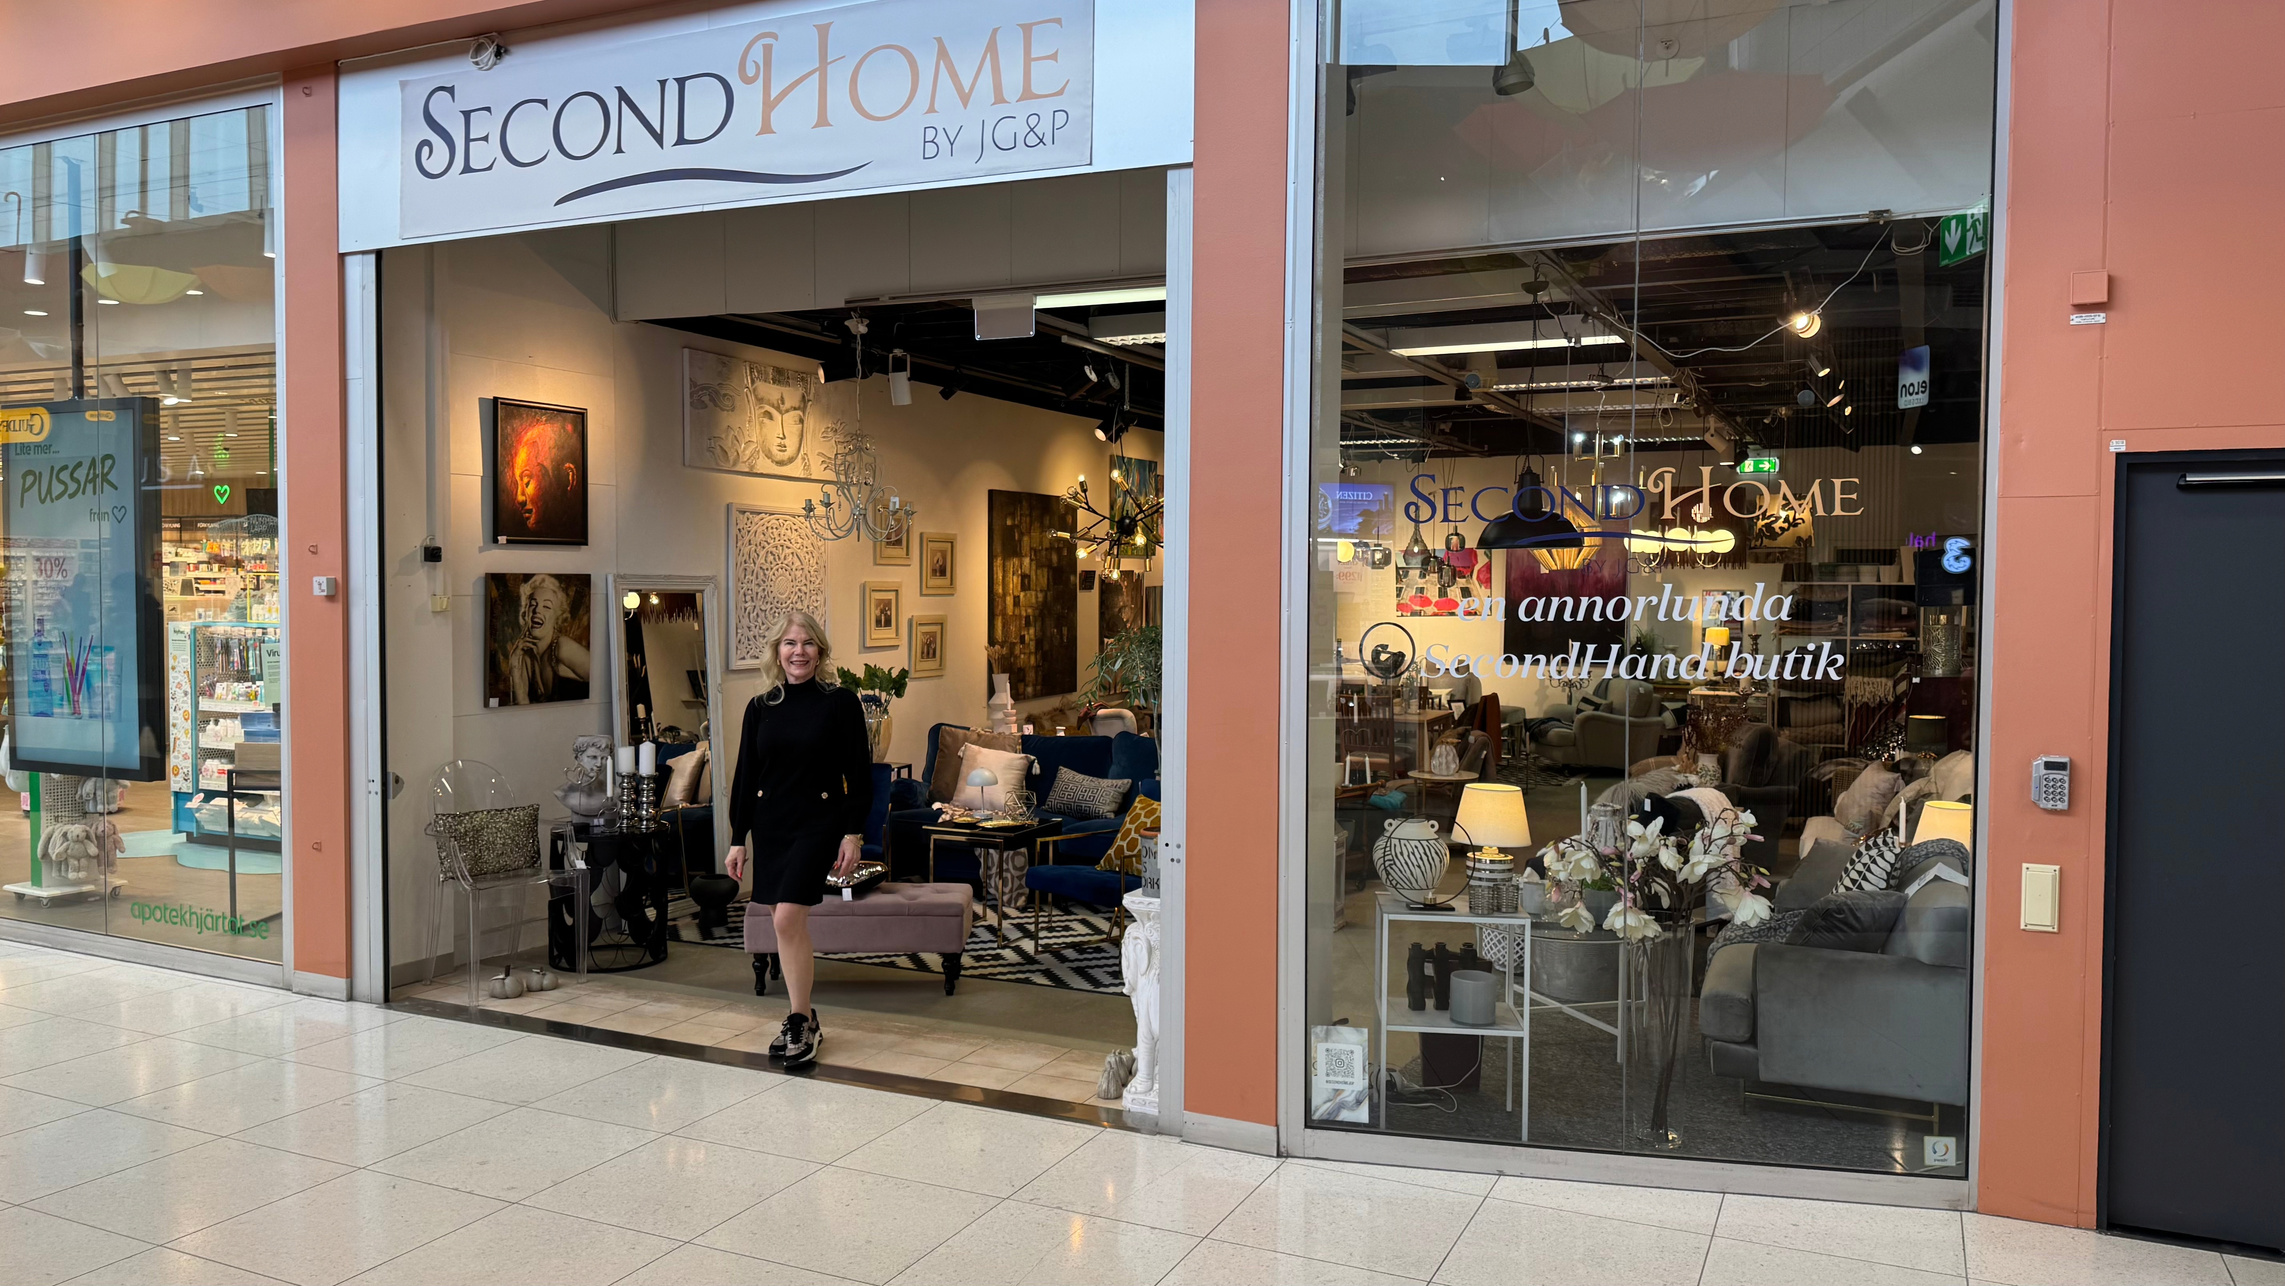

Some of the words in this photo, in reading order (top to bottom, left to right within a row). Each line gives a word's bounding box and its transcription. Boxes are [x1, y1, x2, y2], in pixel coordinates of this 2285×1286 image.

[922, 125, 963, 160] BY
[974, 109, 1070, 164] JG&P
[14, 443, 31, 456] Lite
[20, 453, 118, 508] PUSSAR
[1457, 595, 1507, 622] en
[1517, 582, 1793, 622] annorlunda
[1420, 641, 1713, 680] SecondHand
[1723, 640, 1845, 681] butik
[130, 901, 270, 940] apotekhjärtat.se
